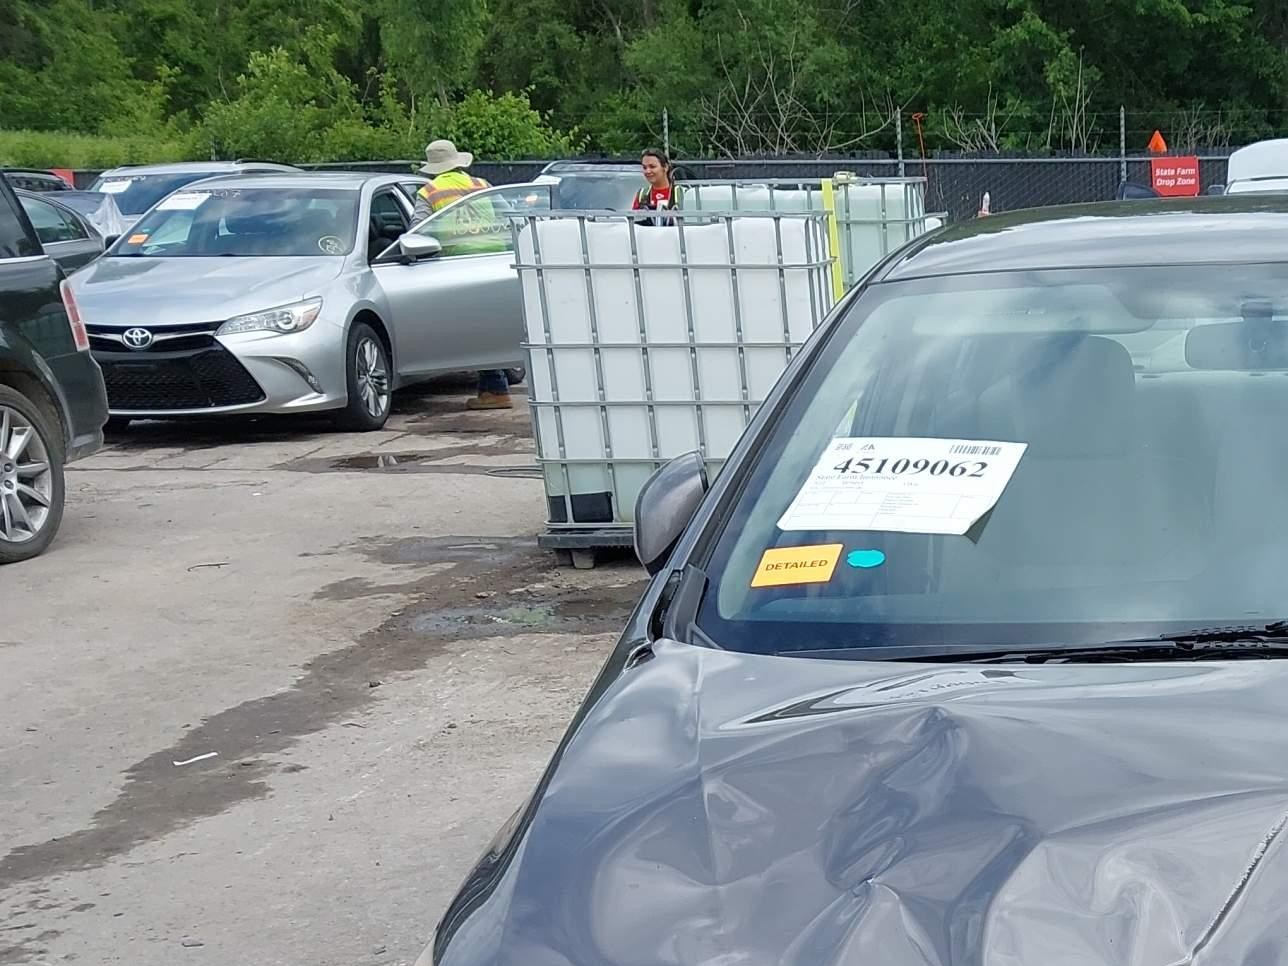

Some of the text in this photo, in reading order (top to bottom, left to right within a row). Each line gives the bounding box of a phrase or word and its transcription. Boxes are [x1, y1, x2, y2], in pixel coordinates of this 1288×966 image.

[1155, 167, 1196, 176] State Farm
[1156, 177, 1196, 187] Drop Zone
[833, 457, 988, 478] 45109062
[765, 559, 829, 571] DETAILED
